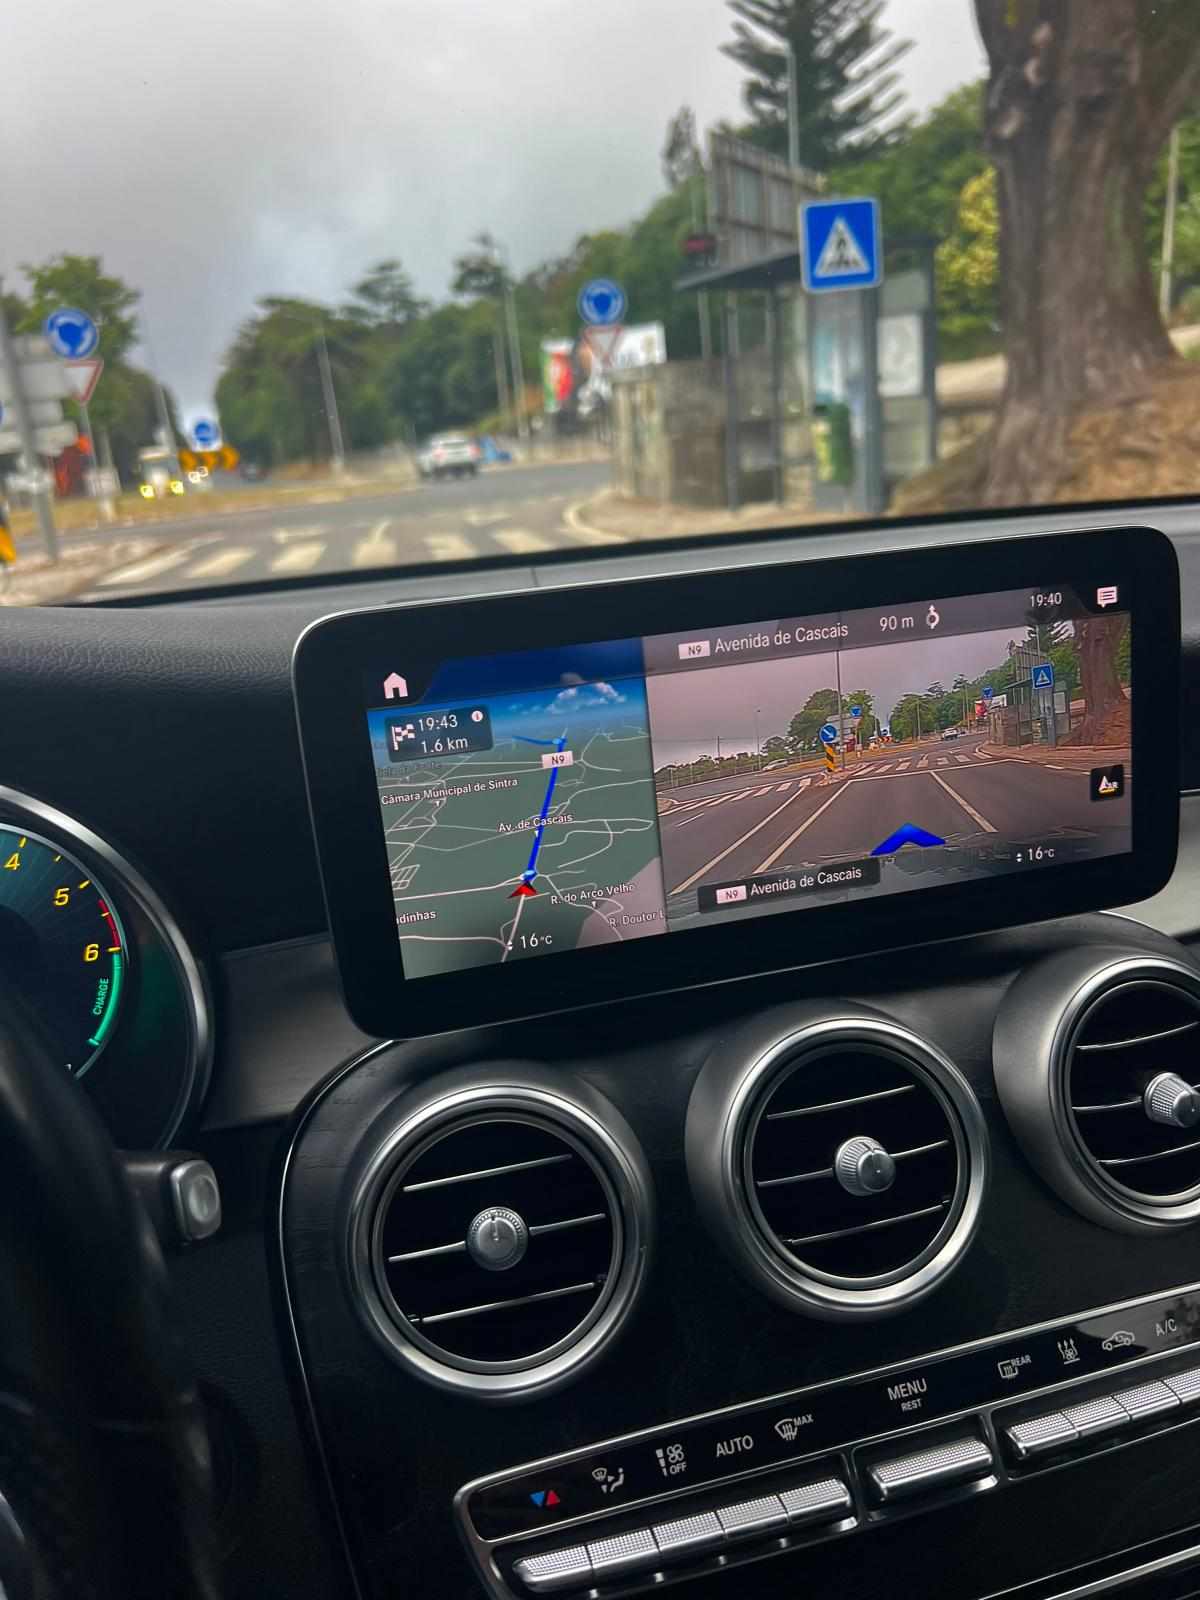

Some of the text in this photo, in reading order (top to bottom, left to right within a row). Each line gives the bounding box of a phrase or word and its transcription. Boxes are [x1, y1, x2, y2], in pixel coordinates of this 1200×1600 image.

[1031, 592, 1062, 607] 19:40
[880, 615, 915, 632] 90 m
[688, 623, 849, 655] N9 Avenida de Cascais
[418, 714, 458, 732] 19:43
[421, 737, 468, 753] 1.6 km
[552, 755, 565, 765] N9
[381, 779, 518, 805] Câmara Municipal de Sintra
[517, 819, 530, 829] de
[533, 814, 573, 827] Cascais
[5, 853, 21, 871] 4
[726, 866, 862, 900] N9 Avenida de Cascais
[54, 887, 70, 906] 5
[565, 893, 577, 903] do
[580, 889, 604, 899] Arco
[622, 911, 657, 925] Doutor
[84, 944, 100, 962] 6
[92, 978, 109, 1016] CHARGE
[1155, 1318, 1177, 1336] A/C
[1011, 1355, 1032, 1367] REAR
[888, 1378, 927, 1400] MENU
[901, 1398, 922, 1412] REST
[793, 1414, 814, 1427] MAX
[716, 1435, 754, 1458] AUTO
[669, 1462, 687, 1475] OFF
